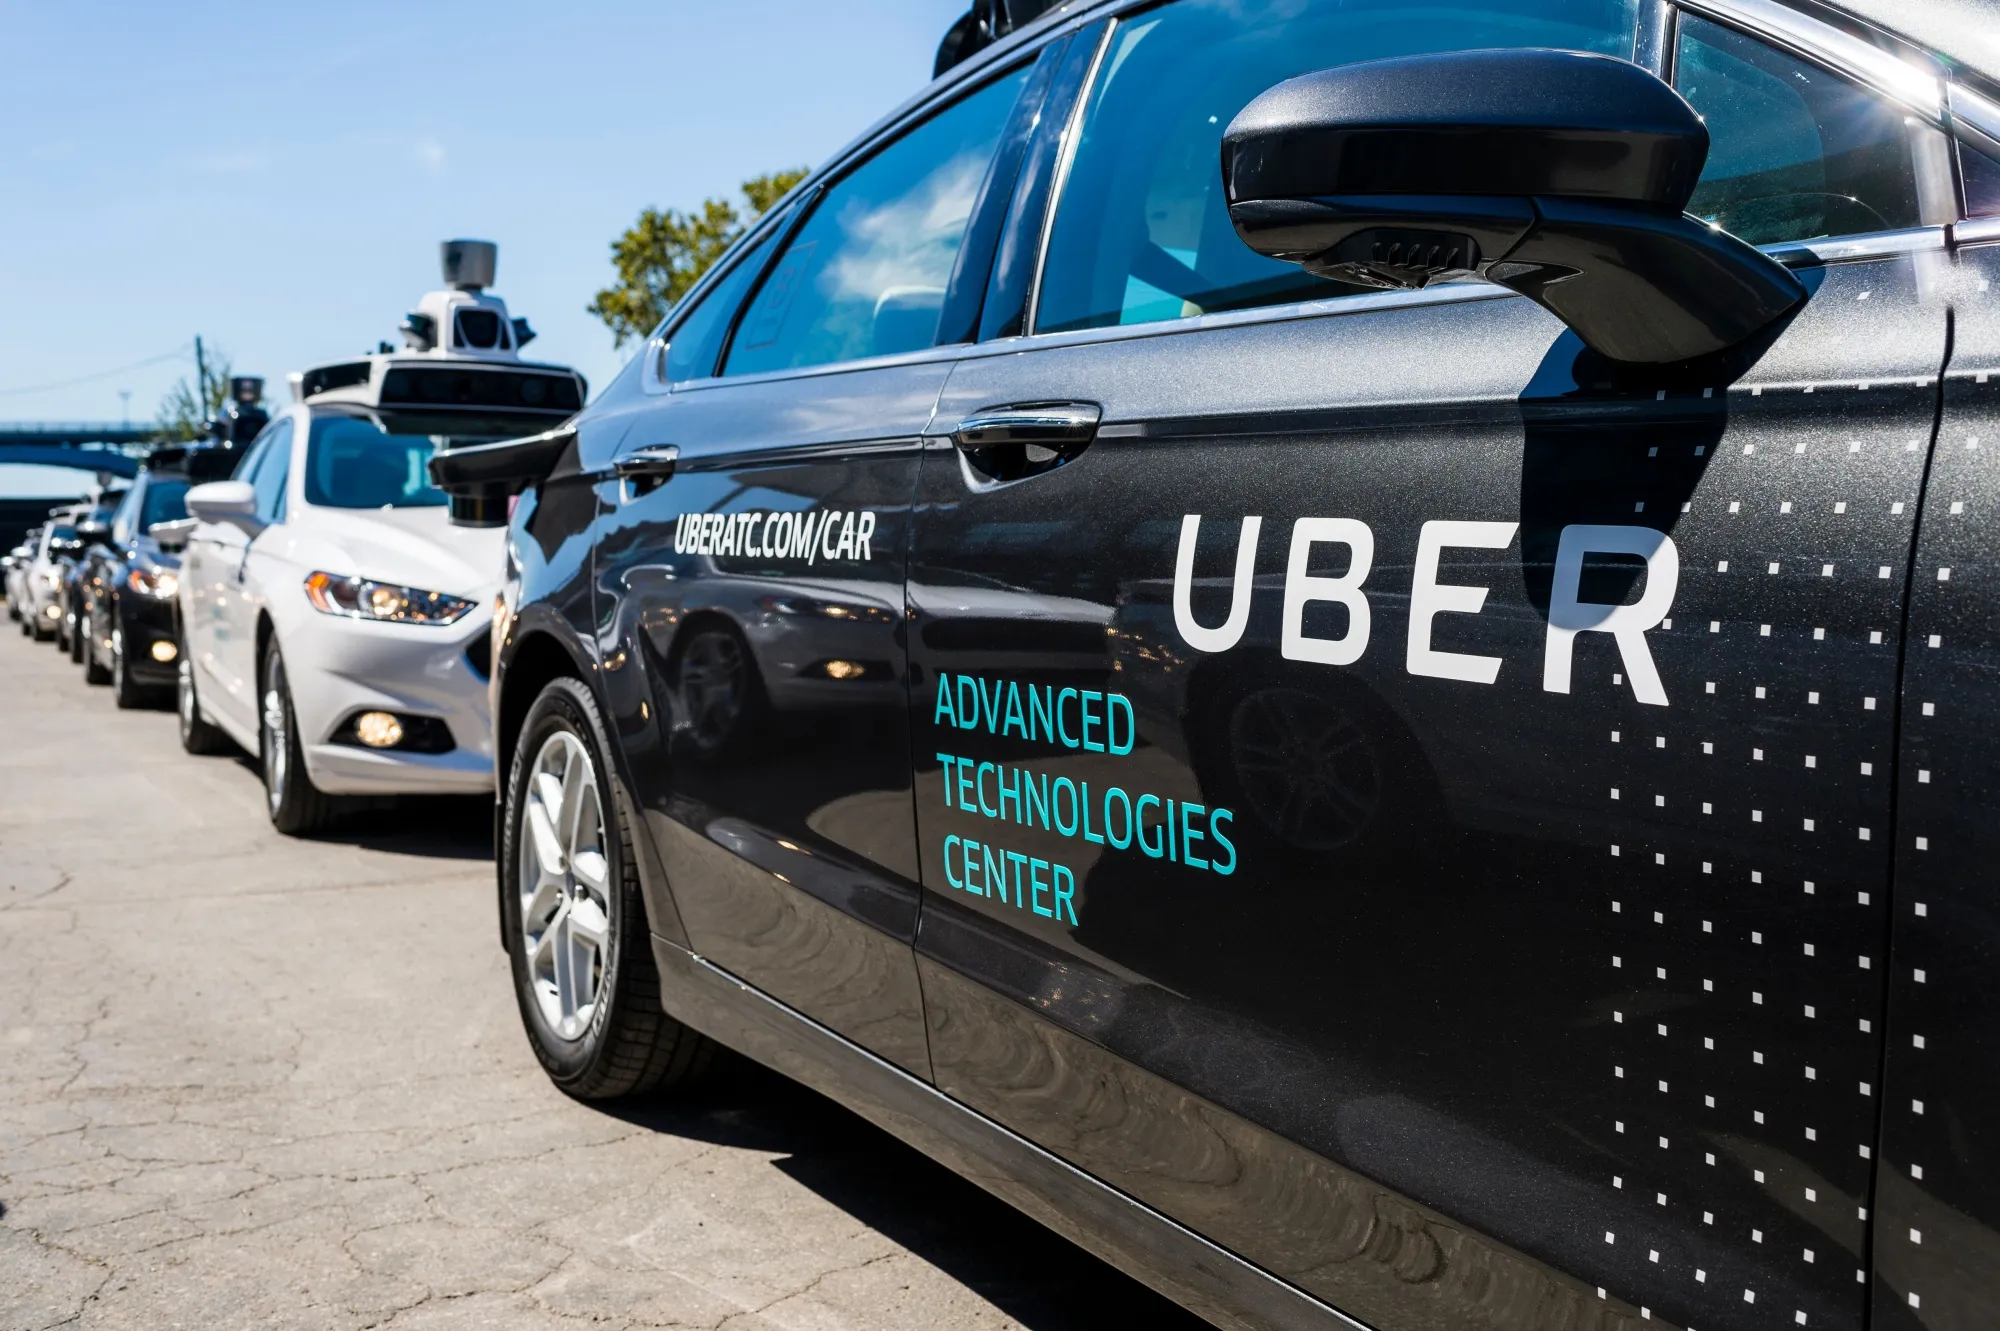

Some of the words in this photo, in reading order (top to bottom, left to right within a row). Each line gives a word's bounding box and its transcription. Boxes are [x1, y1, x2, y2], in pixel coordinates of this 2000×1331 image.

[674, 509, 876, 566] UBERATC.COM/CAR
[1172, 514, 1680, 706] UBER
[934, 672, 1135, 756] ADVANCED
[936, 752, 1237, 875] TECHNOLOGIES
[943, 834, 1079, 927] CENTER
